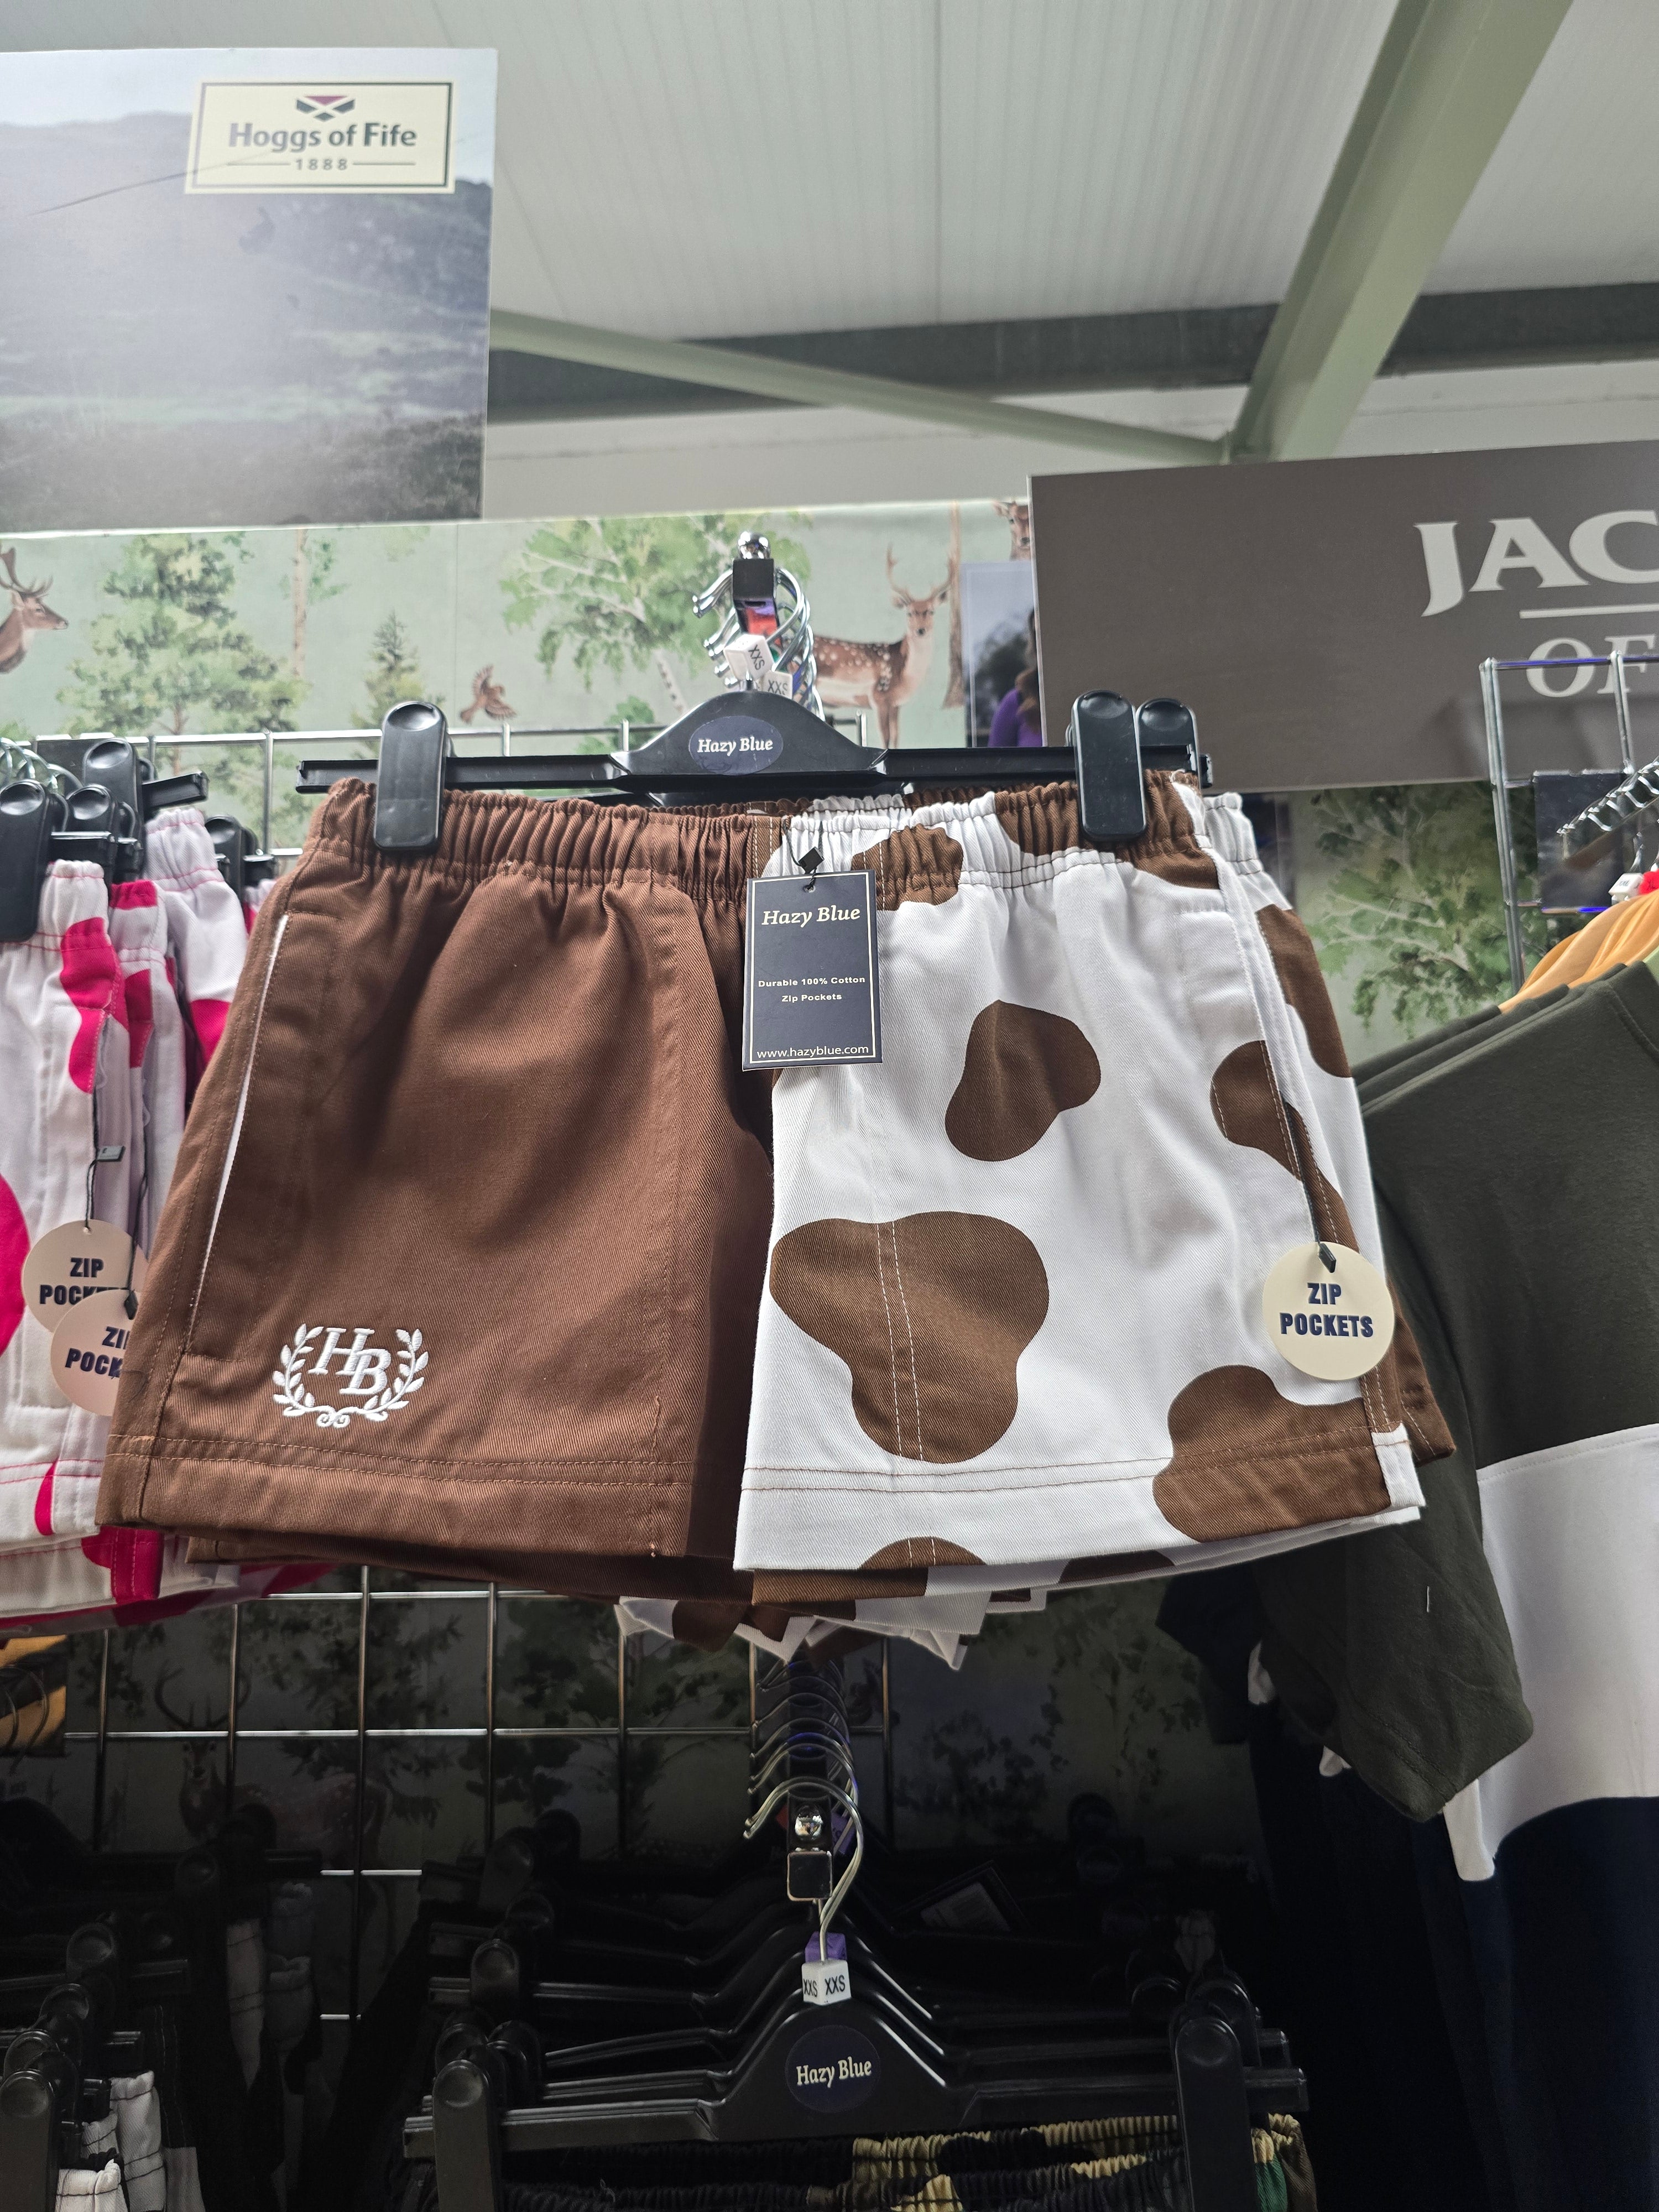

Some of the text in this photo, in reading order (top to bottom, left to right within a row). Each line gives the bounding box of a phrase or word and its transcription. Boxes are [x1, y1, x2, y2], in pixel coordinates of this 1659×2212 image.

[228, 123, 418, 153] Hoggs of Fife
[295, 158, 348, 171] 1888
[748, 644, 765, 670] XXS
[697, 737, 773, 756] Hazy Blue
[761, 905, 860, 928] Hazy Blue
[801, 993, 842, 1001] Pockets
[757, 1046, 869, 1058] www.hazyblue.com
[70, 1257, 105, 1278] ZIP
[1307, 1282, 1342, 1305] ZIP
[1280, 1312, 1374, 1338] POCKETS
[803, 1979, 818, 1997] XXS
[824, 1975, 846, 1996] XXS
[796, 2056, 872, 2088] Hazy Blue
